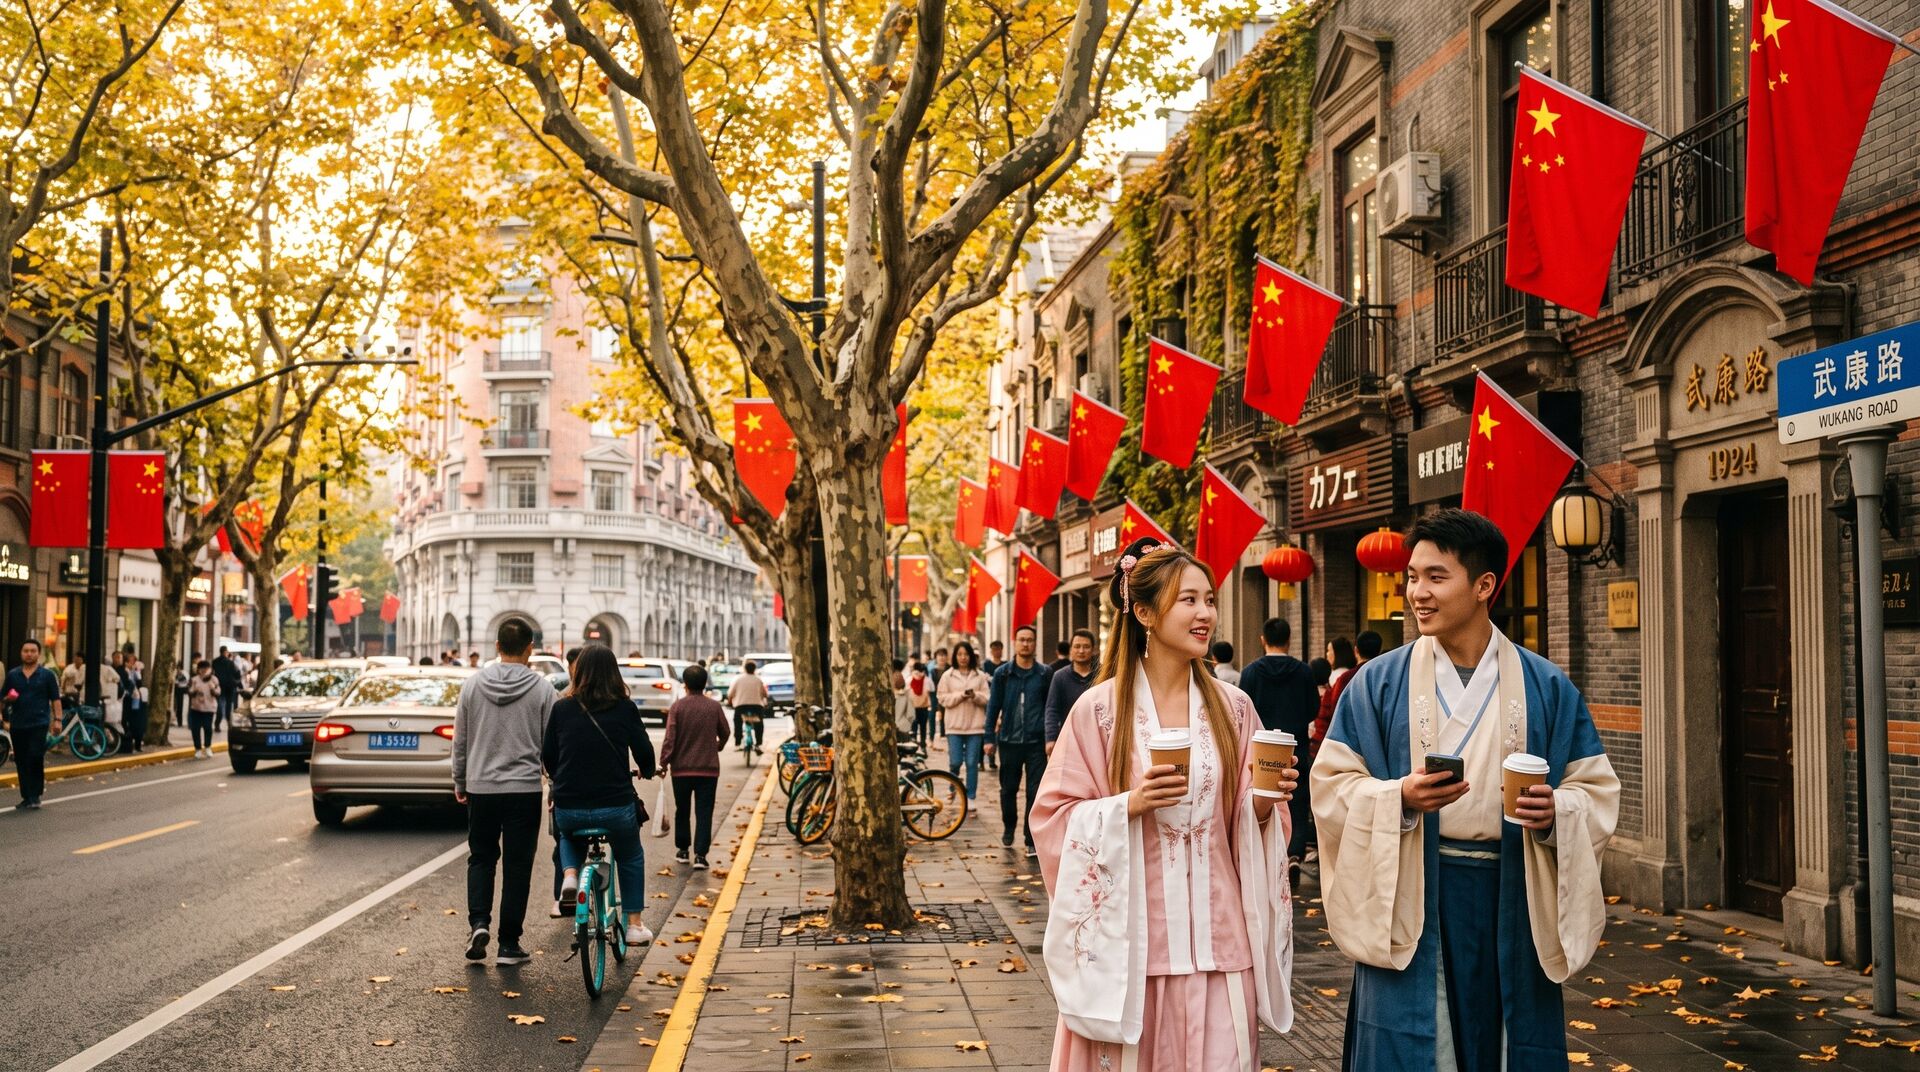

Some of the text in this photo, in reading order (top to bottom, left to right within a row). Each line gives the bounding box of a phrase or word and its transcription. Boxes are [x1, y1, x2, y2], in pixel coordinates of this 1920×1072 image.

[1686, 346, 1771, 412] 武康路
[1813, 340, 1903, 400] 武康路
[1819, 399, 1898, 428] WUKANG ROAD
[1708, 443, 1758, 480] 1924
[1309, 465, 1359, 510] カフェ
